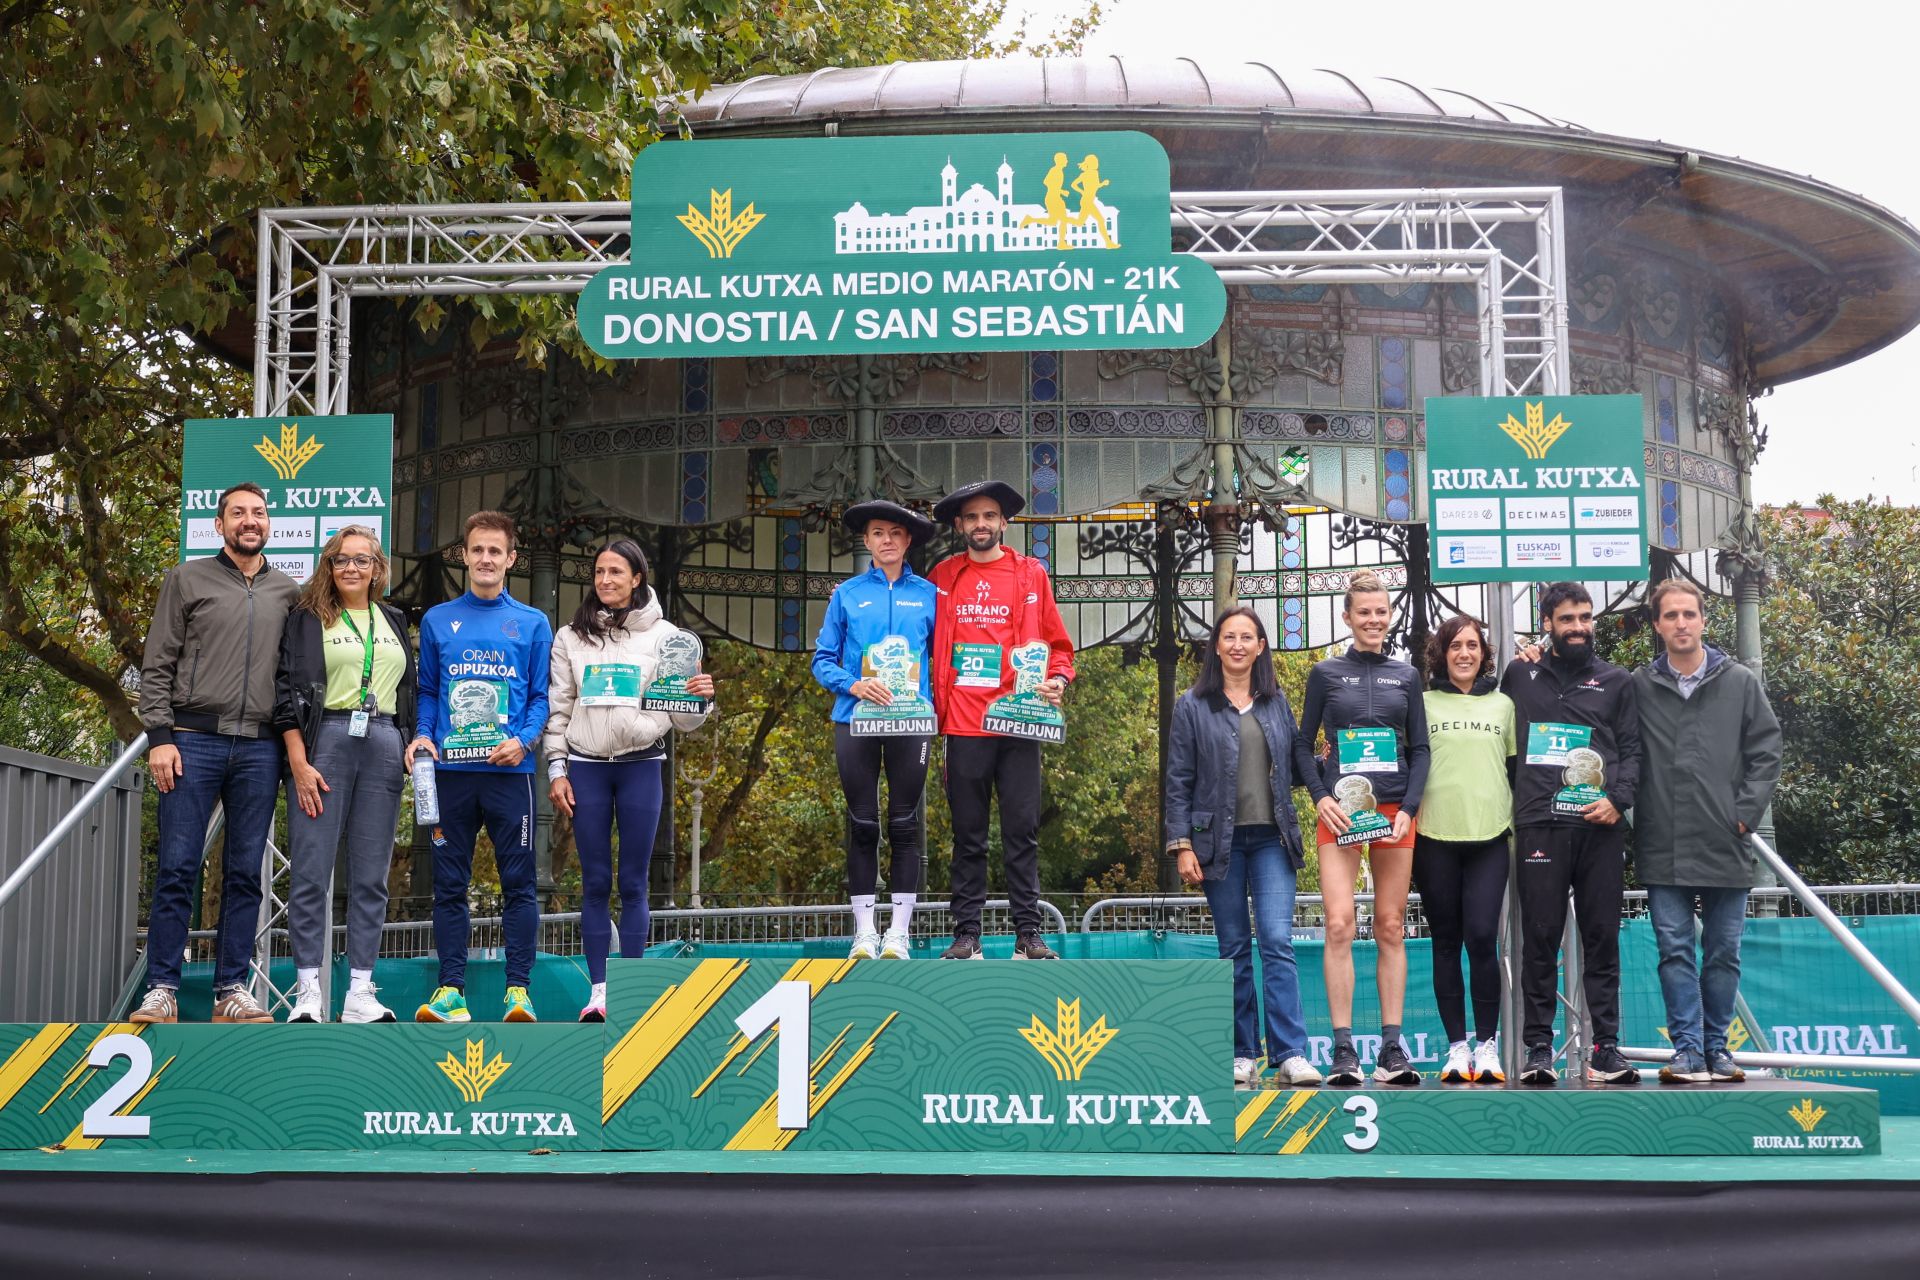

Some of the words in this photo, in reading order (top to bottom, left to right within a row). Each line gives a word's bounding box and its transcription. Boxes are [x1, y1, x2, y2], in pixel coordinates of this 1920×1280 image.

[608, 276, 712, 300] RURAL
[720, 273, 823, 298] KUTXA
[833, 271, 933, 296] MEDIO
[943, 262, 1094, 294] MARATÓN
[1124, 266, 1181, 290] 21K
[604, 310, 818, 345] DONOSTIA
[828, 310, 845, 341] /
[854, 307, 938, 340] SAN
[951, 294, 1184, 338] SEBASTIÁN
[1432, 468, 1528, 490] RURAL
[1536, 467, 1640, 488] KUTXA
[185, 489, 277, 510] RUL
[285, 487, 386, 508] KUTXA
[1508, 510, 1566, 519] DECIMAS
[1595, 509, 1633, 517] ZUBIEDER
[192, 530, 222, 538] DARE
[272, 530, 312, 538] CIMAS
[1517, 543, 1560, 551] EUSKADI
[271, 561, 304, 569] SKADI
[956, 604, 1010, 616] SERRANO
[332, 636, 399, 646] DECMAS
[463, 649, 505, 662] ORAIN
[448, 663, 517, 678] GIPUZKOA
[961, 656, 984, 671] 20
[605, 676, 614, 690] 1
[645, 699, 700, 713] BIGARRENA
[855, 719, 933, 733] TXAPELDUNA
[985, 717, 1061, 740] TXAPELDUNA
[1430, 721, 1501, 735] DECIMAS
[1363, 741, 1375, 756] 2
[1549, 736, 1568, 750] 11
[447, 746, 496, 760] BIGARRE
[521, 815, 529, 846] macron
[1337, 827, 1392, 845] HIRUGARRENA
[1772, 1024, 1908, 1055] RURAL
[735, 981, 809, 1128] 1
[1307, 1032, 1439, 1067] RRAL
[83, 1034, 151, 1135] 2
[922, 1093, 1055, 1124] RURAL
[1066, 1094, 1211, 1125] KUTXA
[363, 1111, 462, 1135] RURAL
[470, 1112, 577, 1136] KUTXA
[1342, 1094, 1380, 1152] 3
[1752, 1135, 1804, 1149] RURAL
[1807, 1135, 1864, 1149] KUTXA
